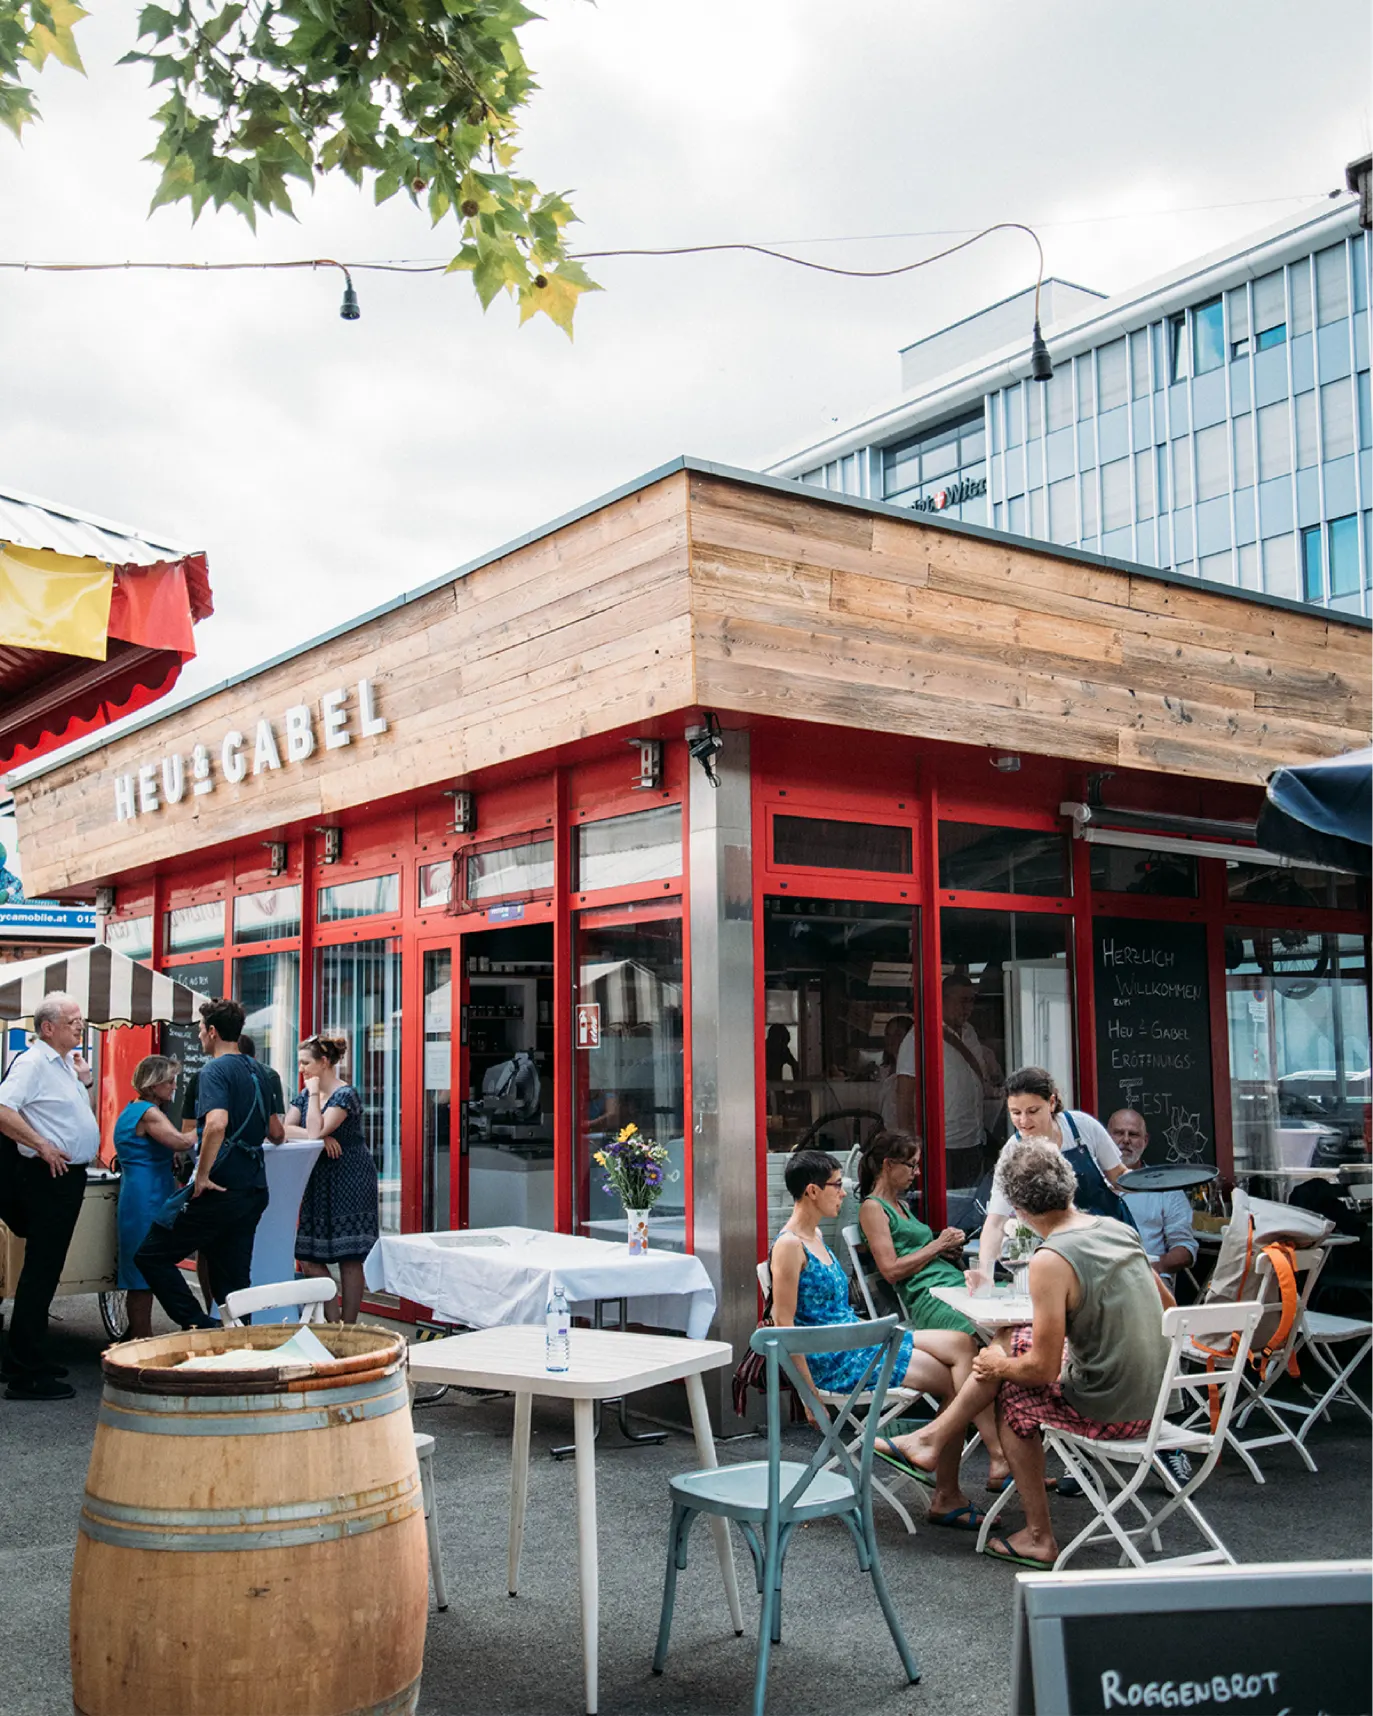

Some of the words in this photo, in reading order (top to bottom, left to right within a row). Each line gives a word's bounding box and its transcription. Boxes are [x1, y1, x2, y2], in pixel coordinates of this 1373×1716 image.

[114, 753, 185, 822] HEU
[193, 743, 213, 796] &
[221, 678, 388, 784] GABEL
[1113, 998, 1131, 1007] ZUM
[1115, 972, 1202, 1001] WILLKOMMEN
[1108, 1018, 1133, 1040] HEU
[1151, 1019, 1191, 1041] GABEL
[1119, 1077, 1173, 1116] FEST
[1101, 1669, 1280, 1709] ROGGENBROT
